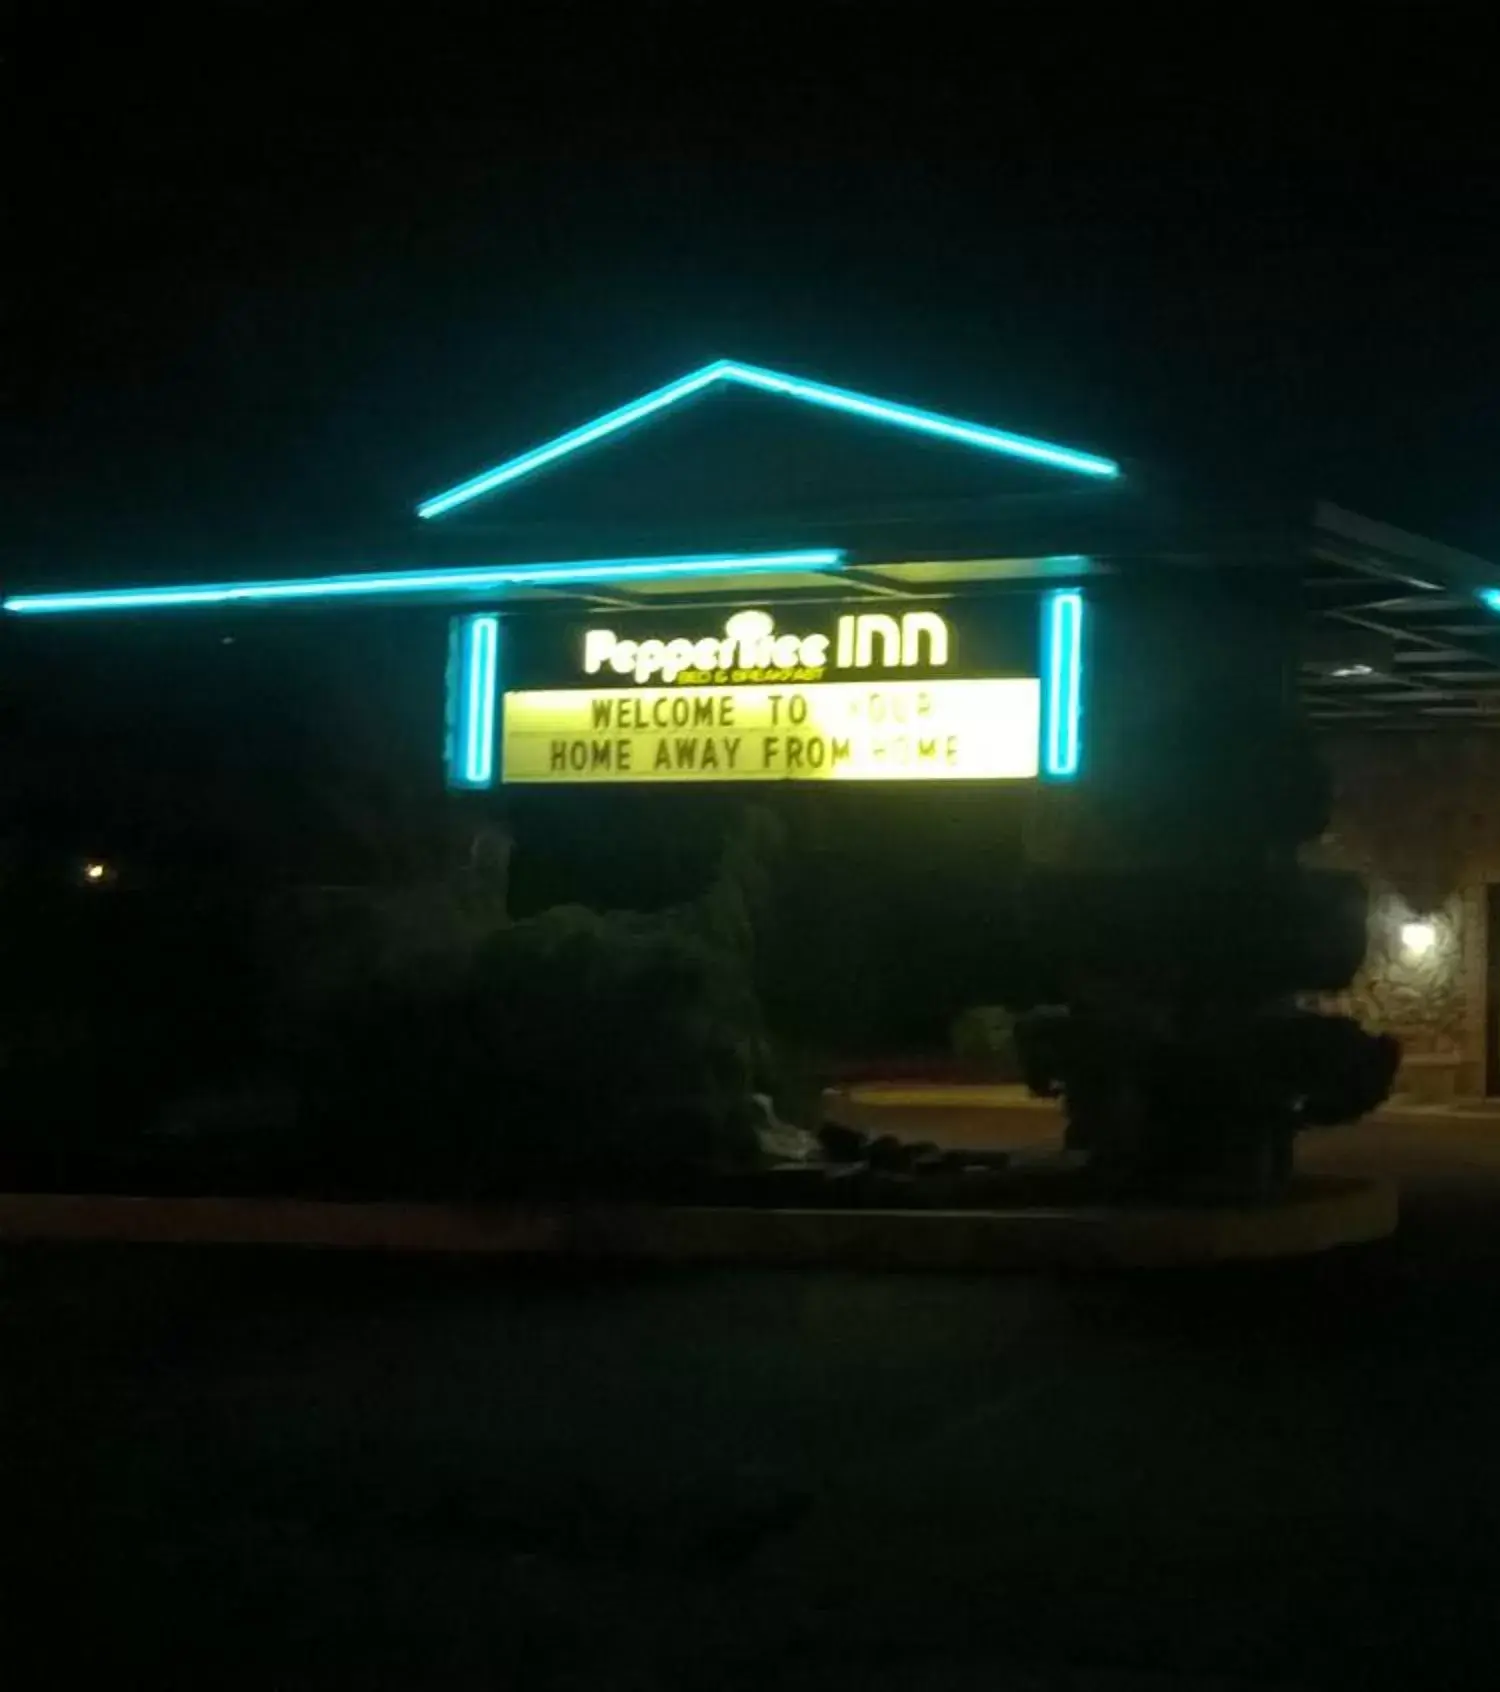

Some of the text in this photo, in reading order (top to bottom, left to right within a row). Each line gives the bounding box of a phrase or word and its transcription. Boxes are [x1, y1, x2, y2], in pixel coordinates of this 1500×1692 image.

[591, 691, 935, 729] WELCOME TO OUR
[550, 733, 960, 771] HOME AWAY FROM ME
